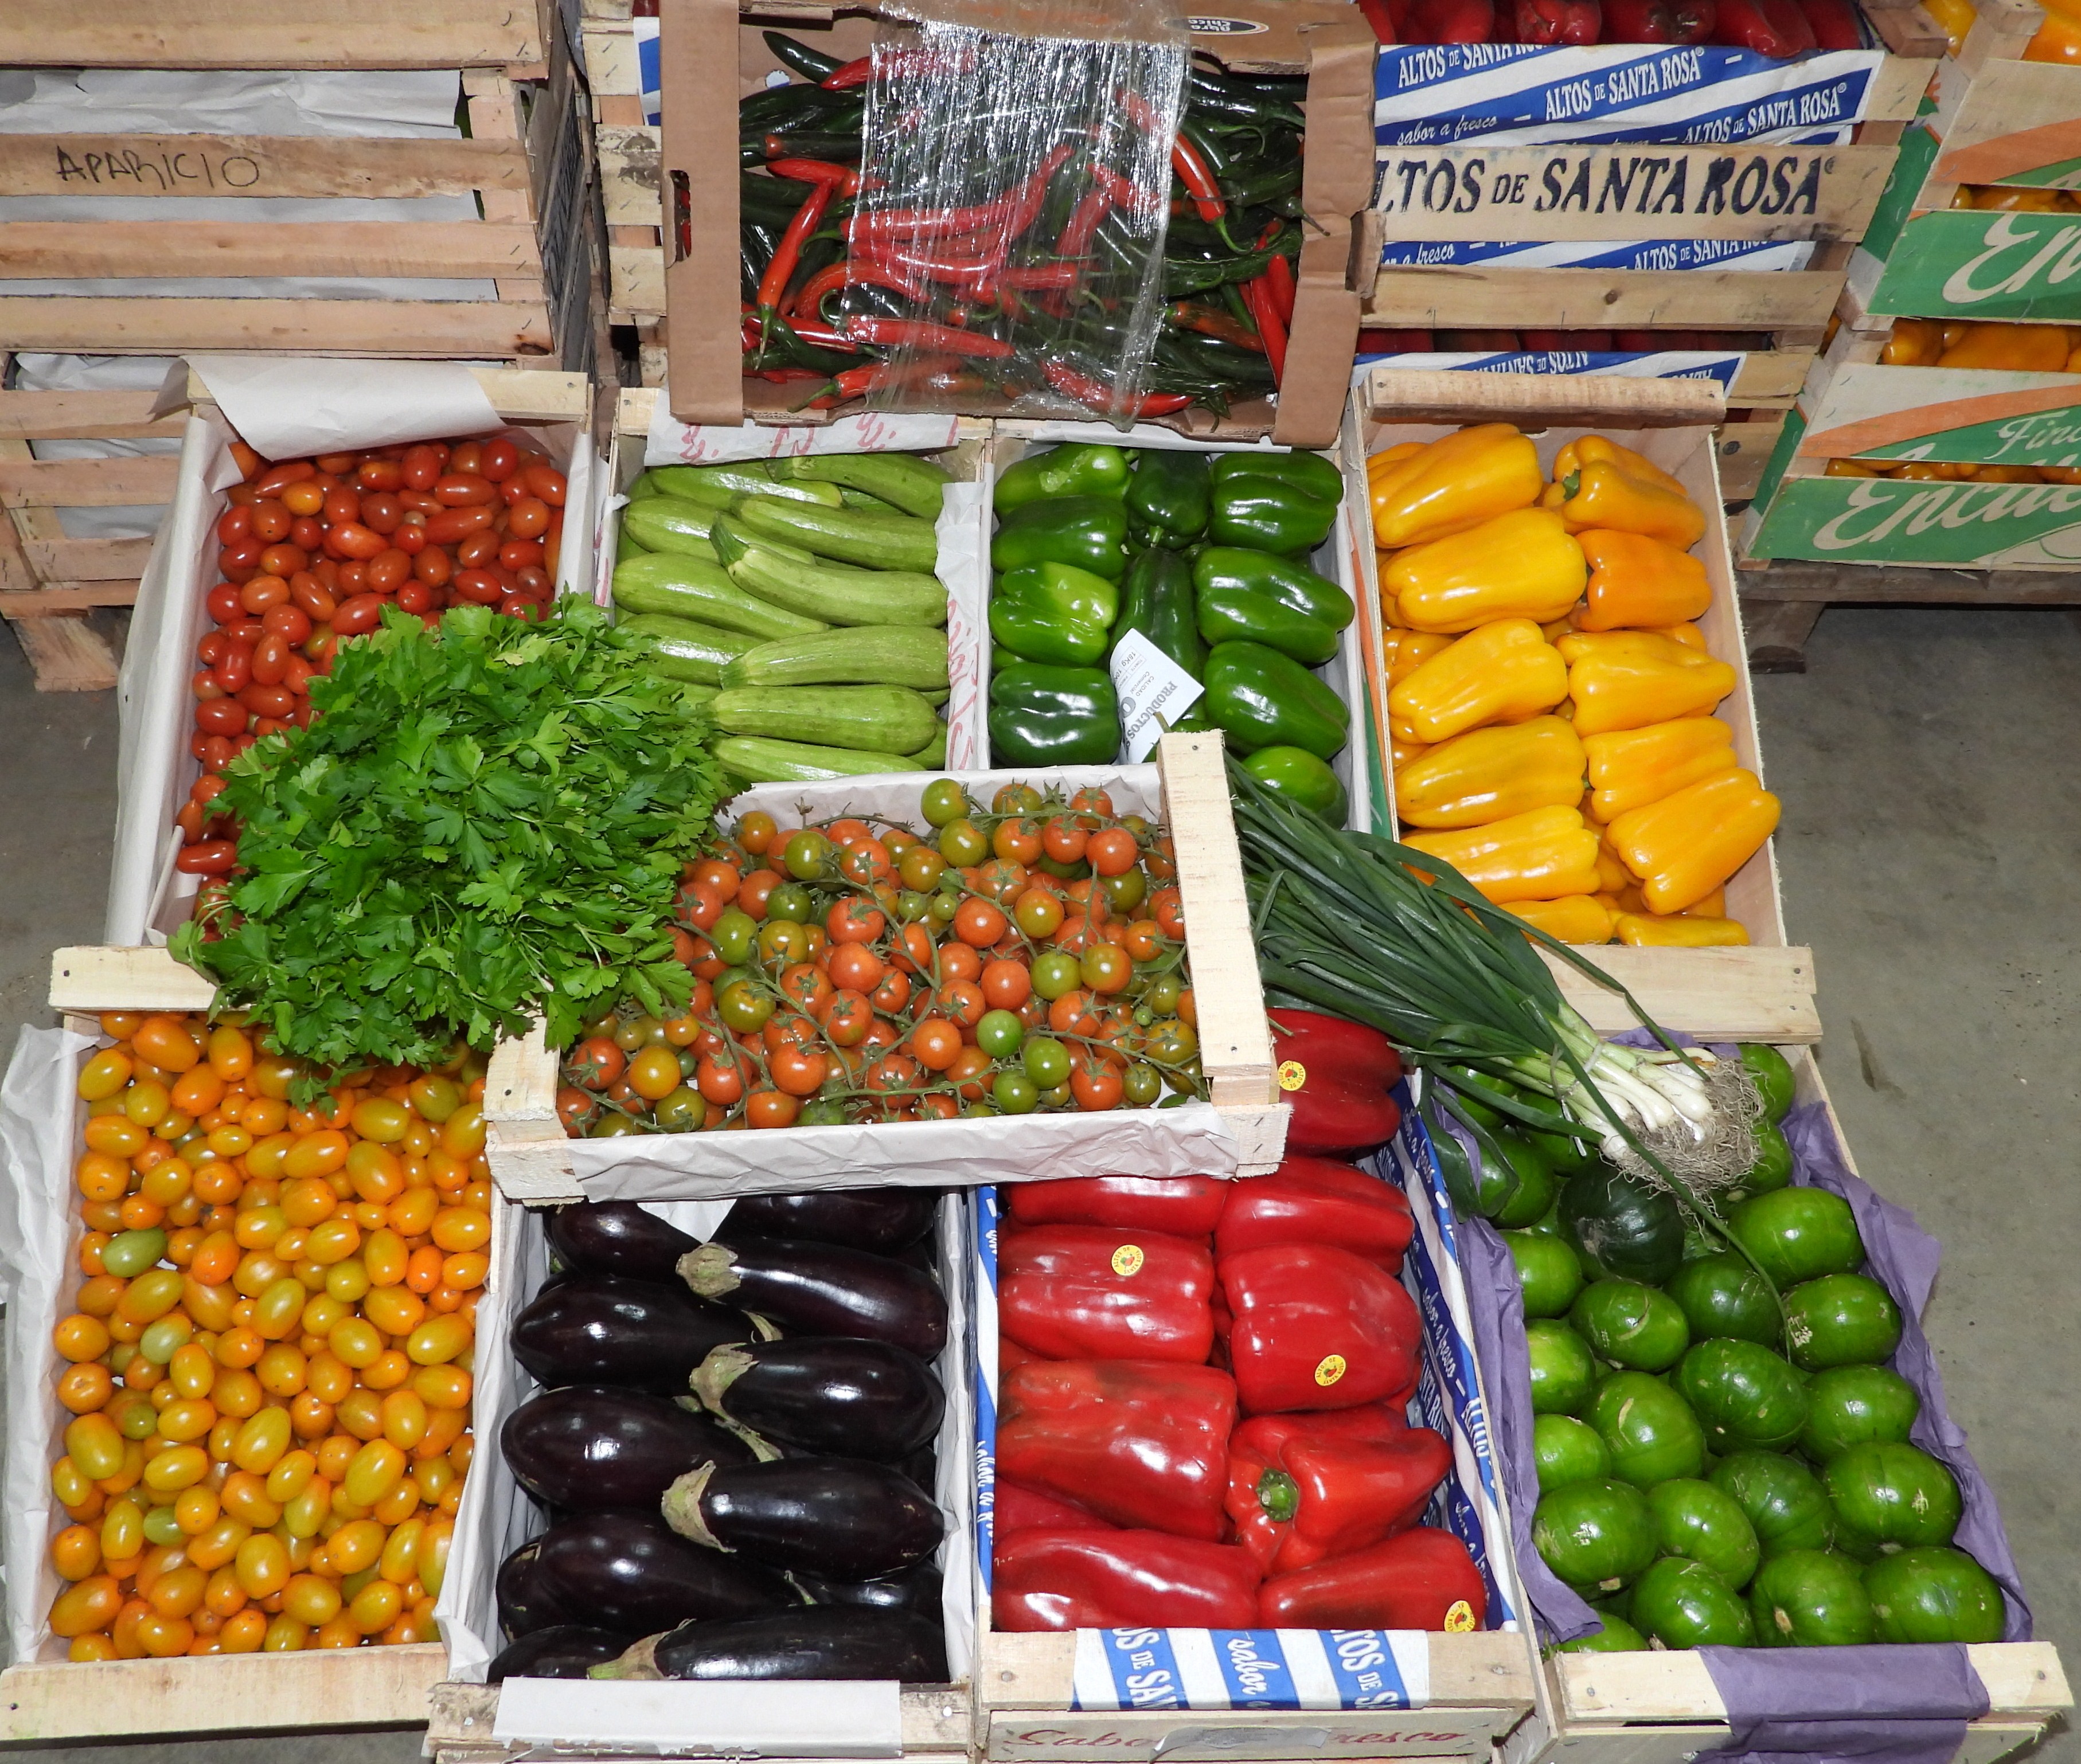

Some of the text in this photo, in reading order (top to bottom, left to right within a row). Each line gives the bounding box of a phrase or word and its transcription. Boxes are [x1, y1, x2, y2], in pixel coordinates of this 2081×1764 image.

[1399, 46, 1446, 88] ALTOS
[1449, 50, 1460, 67] DE
[1397, 121, 1436, 145] sabor
[1440, 123, 1451, 136] a
[1454, 115, 1498, 140] fresco
[1546, 79, 1592, 122] ALTOS
[1594, 83, 1606, 101] DE
[1608, 62, 1659, 105] SANTA
[1682, 116, 1731, 143] ALTOS
[1733, 118, 1744, 134] DE
[1747, 98, 1797, 135] SANTA
[1490, 173, 1529, 204] DE
[1533, 155, 1688, 216] SANTA
[1635, 243, 1677, 270] ALTOS
[1680, 247, 1690, 261] DE
[1135, 675, 1155, 697] CALIDAD
[1127, 680, 1178, 740] PRODUCTOS
[1130, 1650, 1155, 1670] DE
[1227, 1632, 1280, 1695] sabor
[1357, 1671, 1383, 1692] DE
